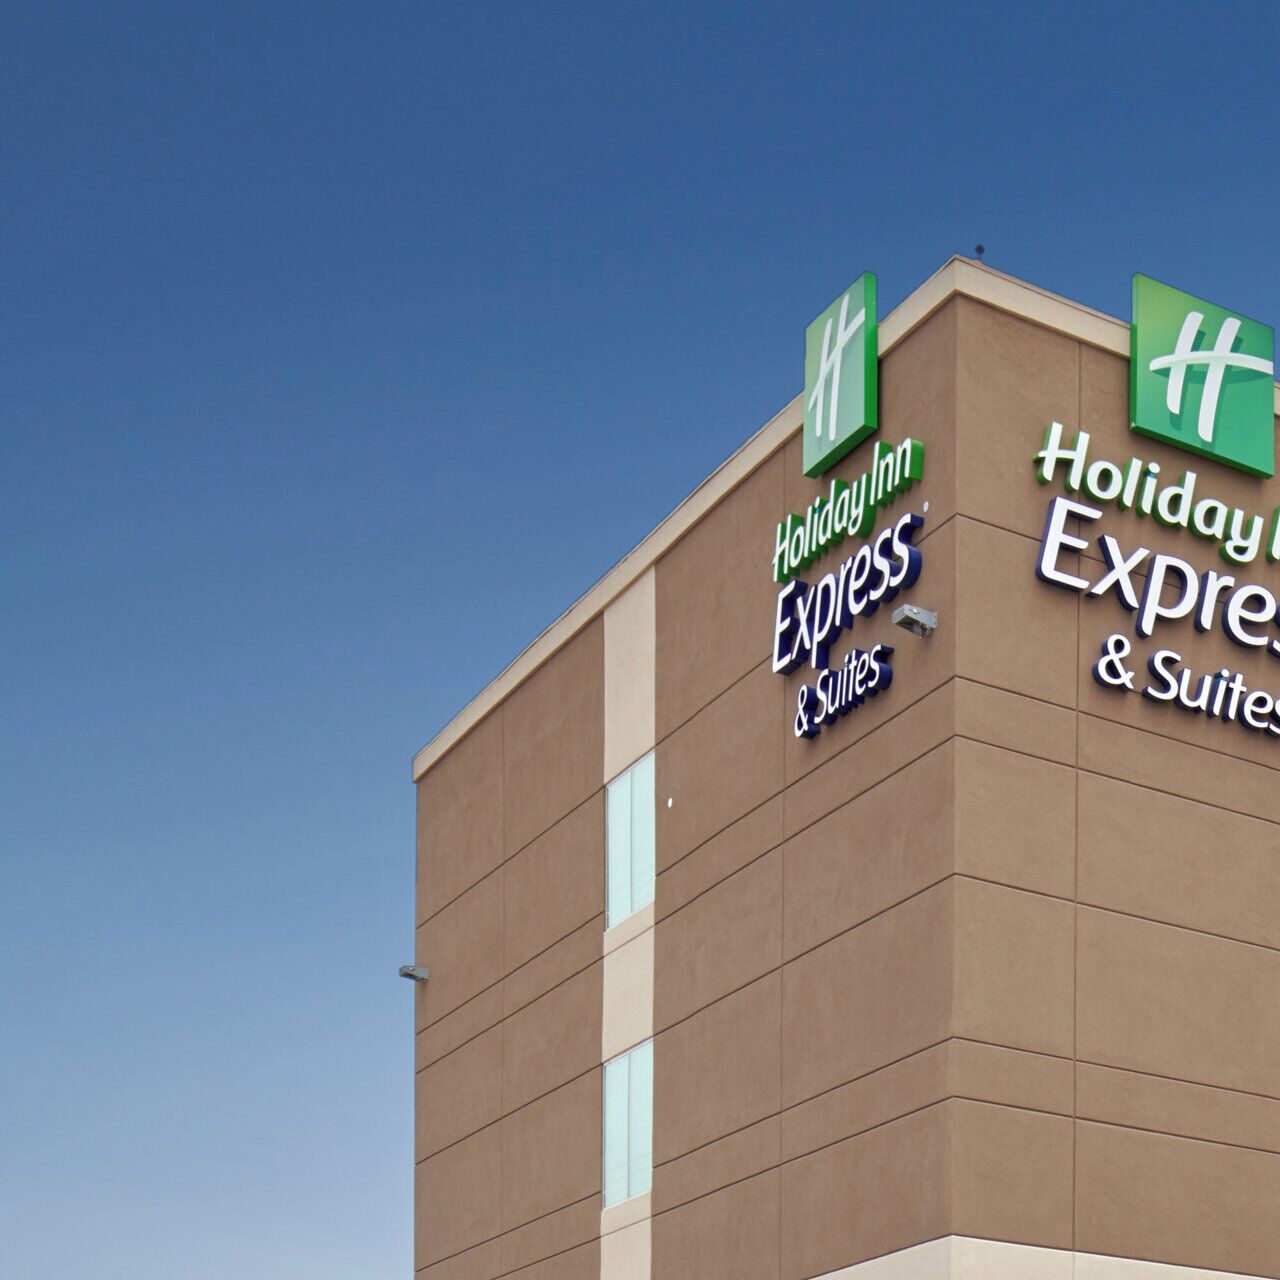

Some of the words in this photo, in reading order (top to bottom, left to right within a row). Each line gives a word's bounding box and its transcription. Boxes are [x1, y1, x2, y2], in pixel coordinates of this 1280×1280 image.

[771, 473, 868, 582] Holiday
[869, 437, 916, 506] Inn
[1036, 421, 1265, 564] Holiday
[771, 512, 914, 674] Express
[1096, 633, 1135, 690] &
[793, 684, 810, 738] &
[814, 643, 884, 725] Suites
